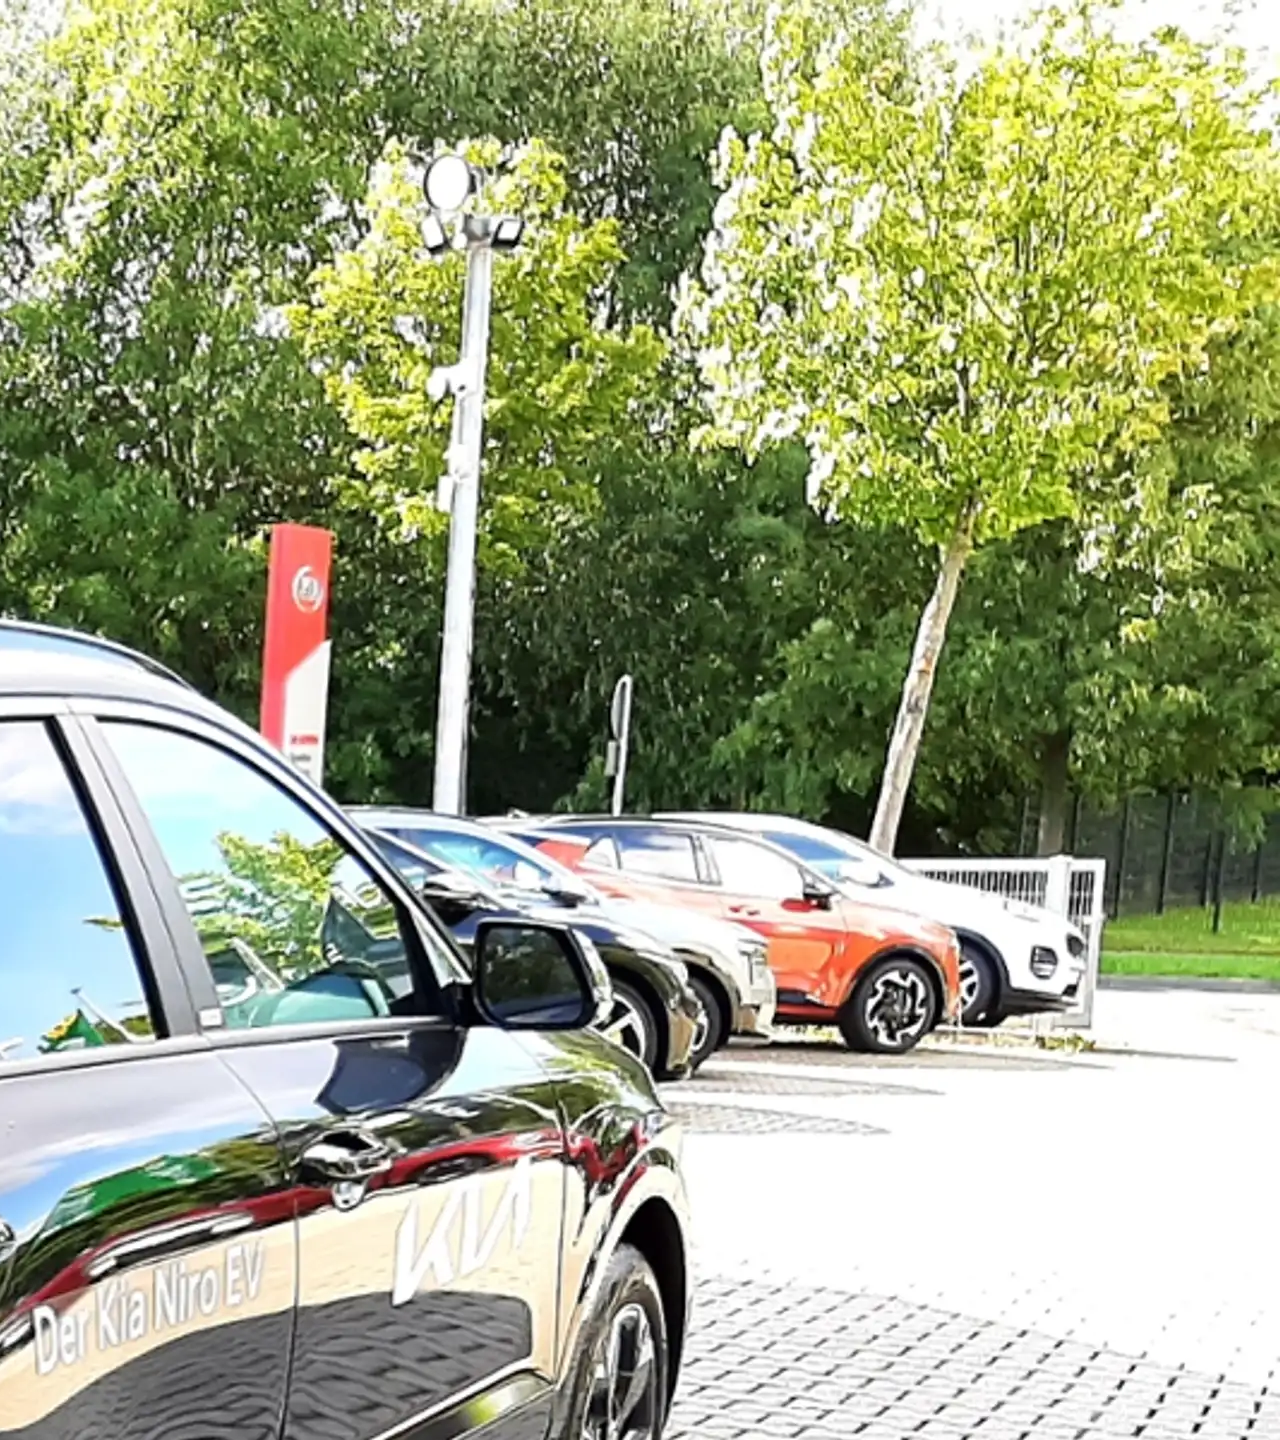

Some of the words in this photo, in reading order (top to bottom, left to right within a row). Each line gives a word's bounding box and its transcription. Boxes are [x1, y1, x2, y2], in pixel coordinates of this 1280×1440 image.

[392, 1156, 534, 1306] KIA
[33, 1303, 88, 1377] Der
[97, 1272, 145, 1349] Kia
[152, 1252, 220, 1332] Niro
[226, 1236, 265, 1303] EV
